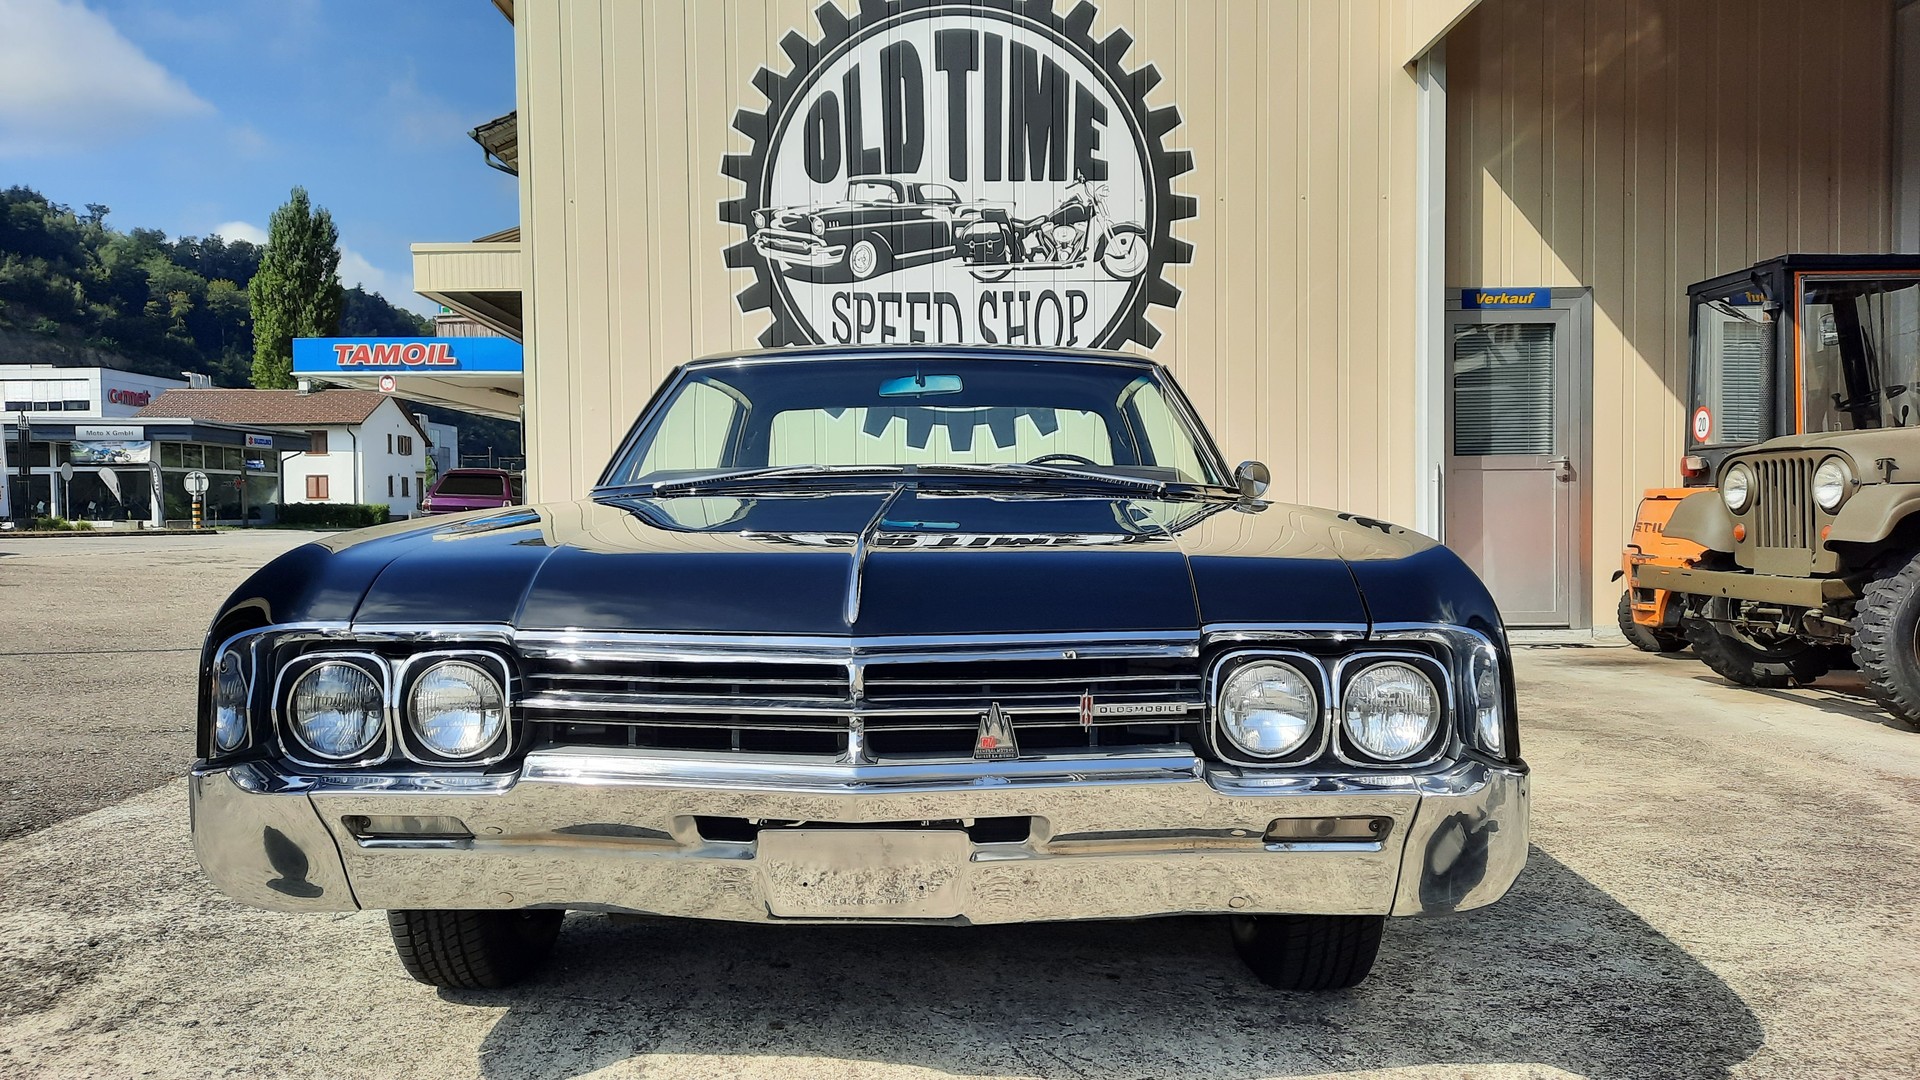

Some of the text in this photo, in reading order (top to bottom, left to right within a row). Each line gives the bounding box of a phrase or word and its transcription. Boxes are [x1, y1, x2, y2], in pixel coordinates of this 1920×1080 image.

[1476, 292, 1535, 305] Verkauf
[832, 289, 1088, 346] SPEED SHOP
[333, 344, 457, 366] TAMOIL
[1698, 417, 1707, 432] 20
[1100, 705, 1182, 713] OLDSMOBILE
